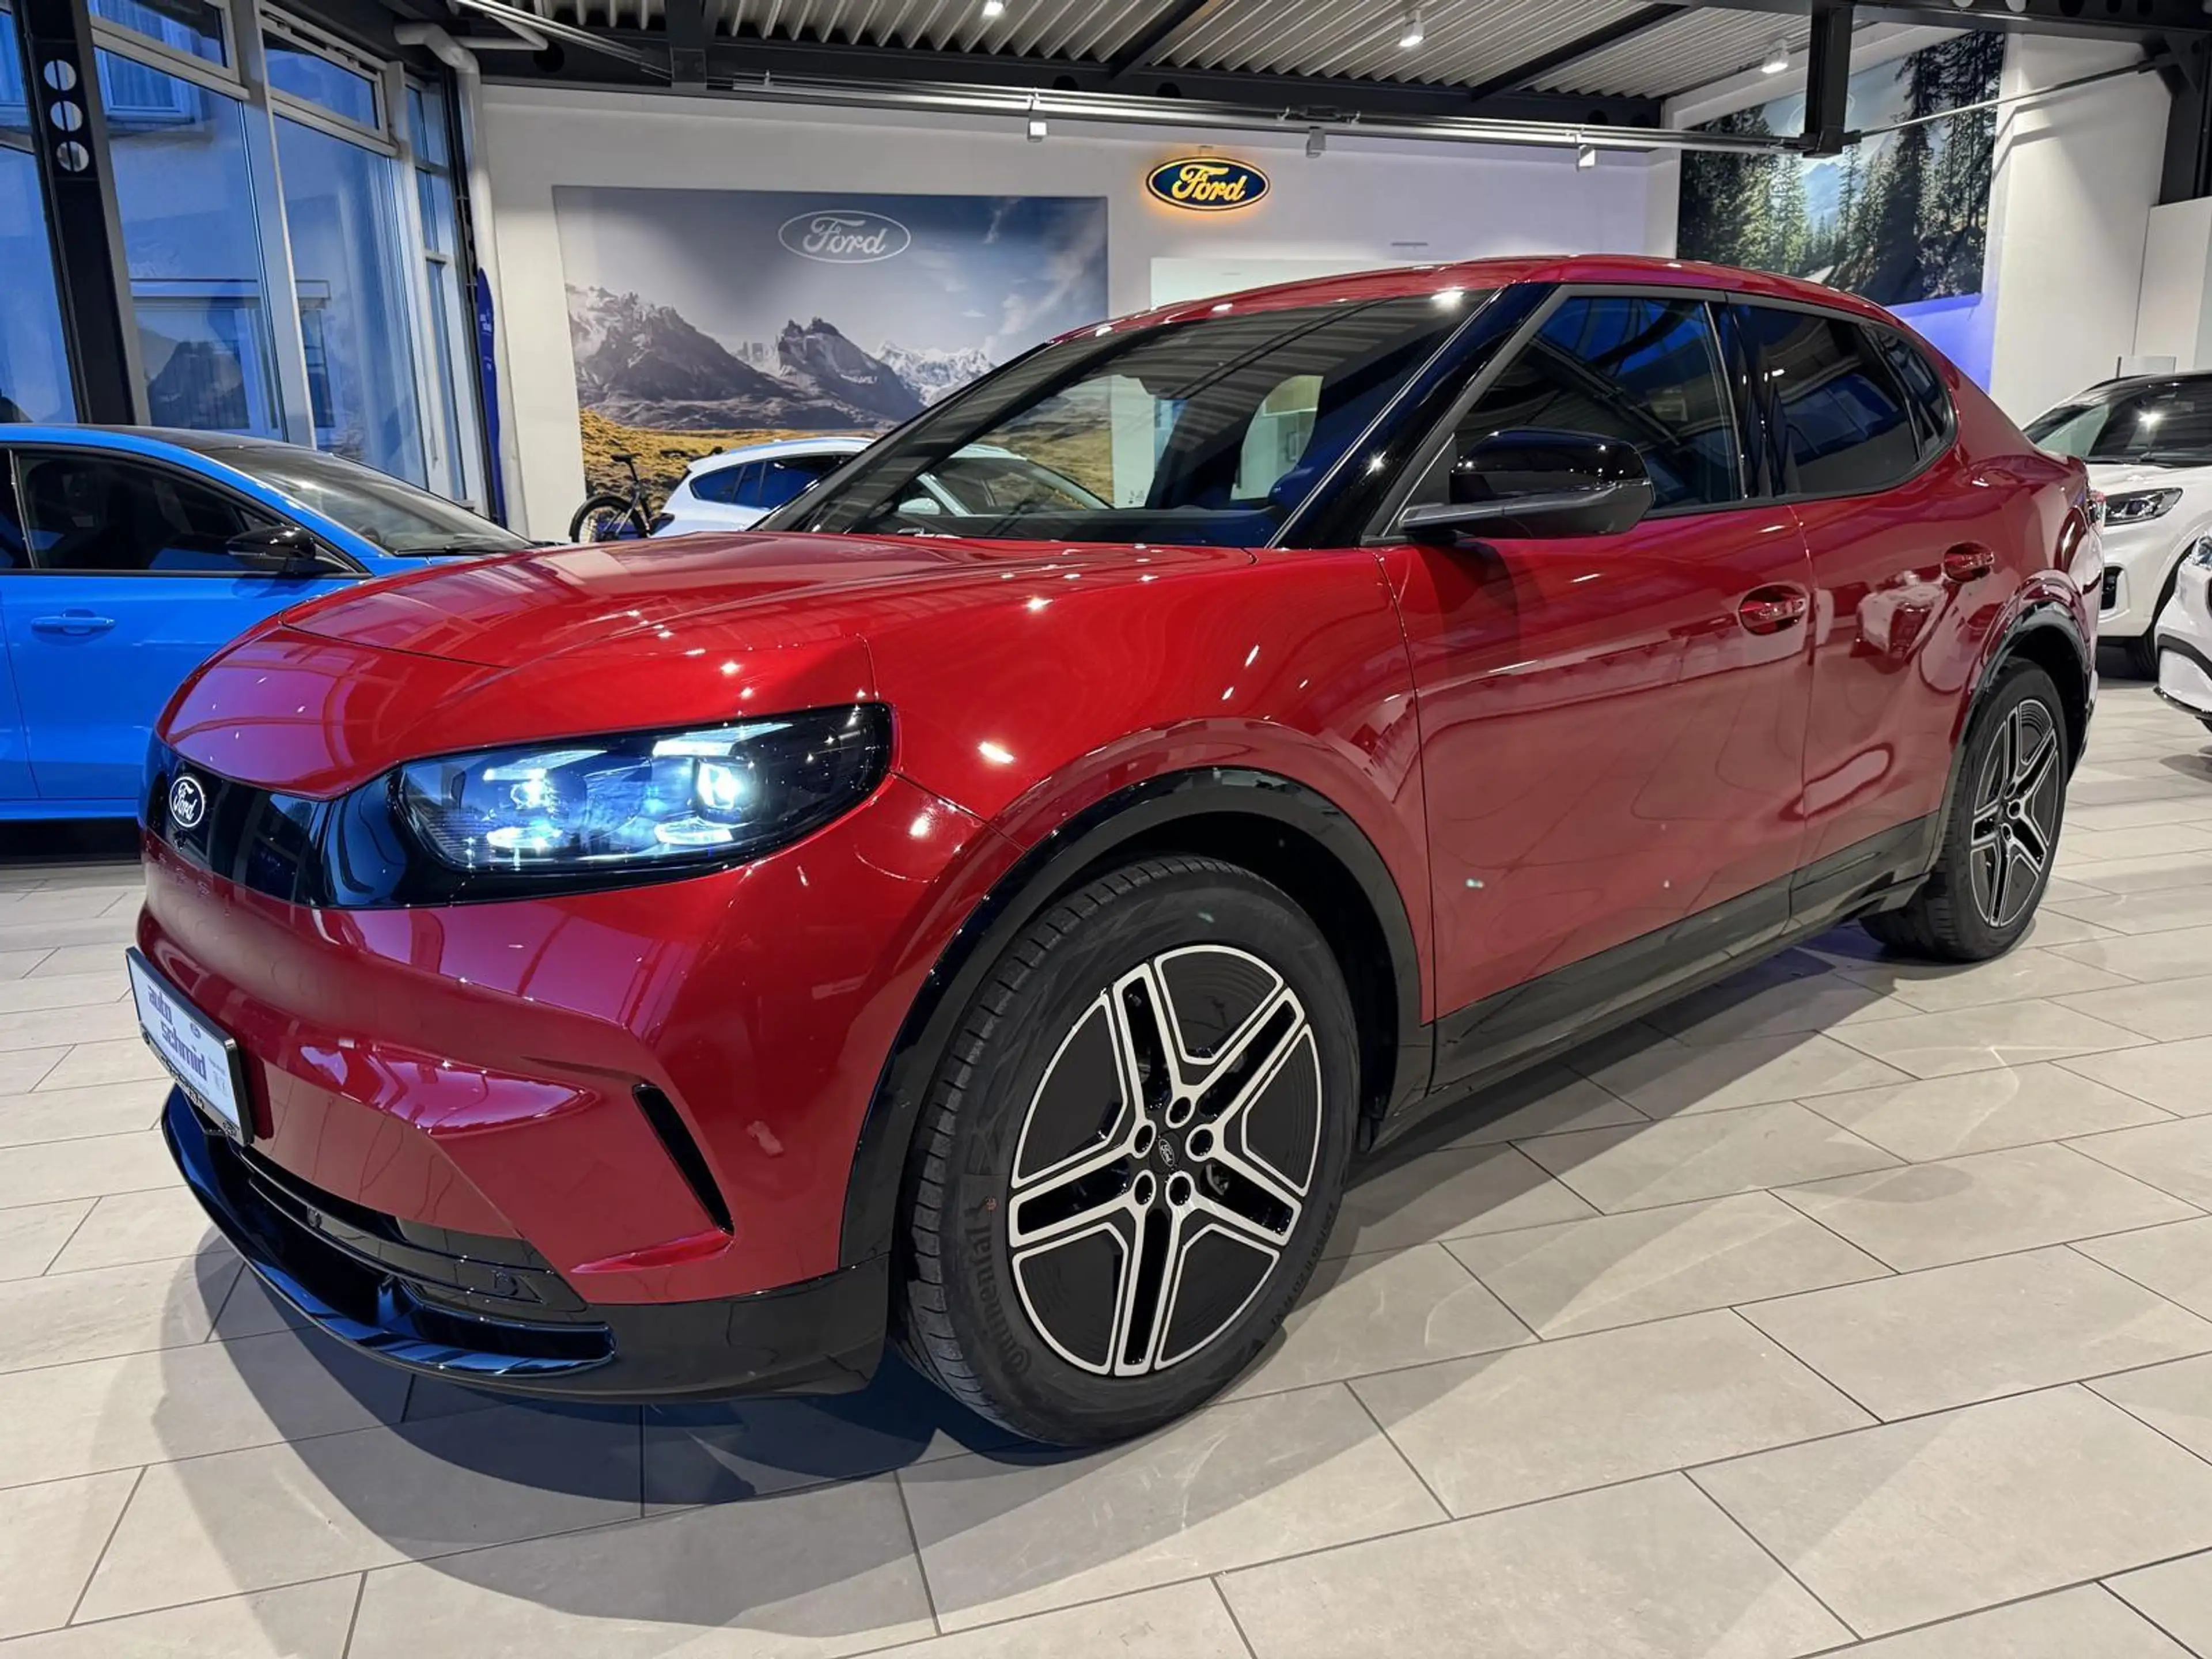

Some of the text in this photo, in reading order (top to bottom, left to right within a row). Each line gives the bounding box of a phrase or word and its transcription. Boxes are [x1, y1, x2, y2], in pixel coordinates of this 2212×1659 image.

[1171, 164, 1249, 202] Ford
[802, 217, 887, 255] Ford
[173, 782, 198, 820] Ford
[148, 986, 172, 1024] auto
[161, 1020, 207, 1082] schmid
